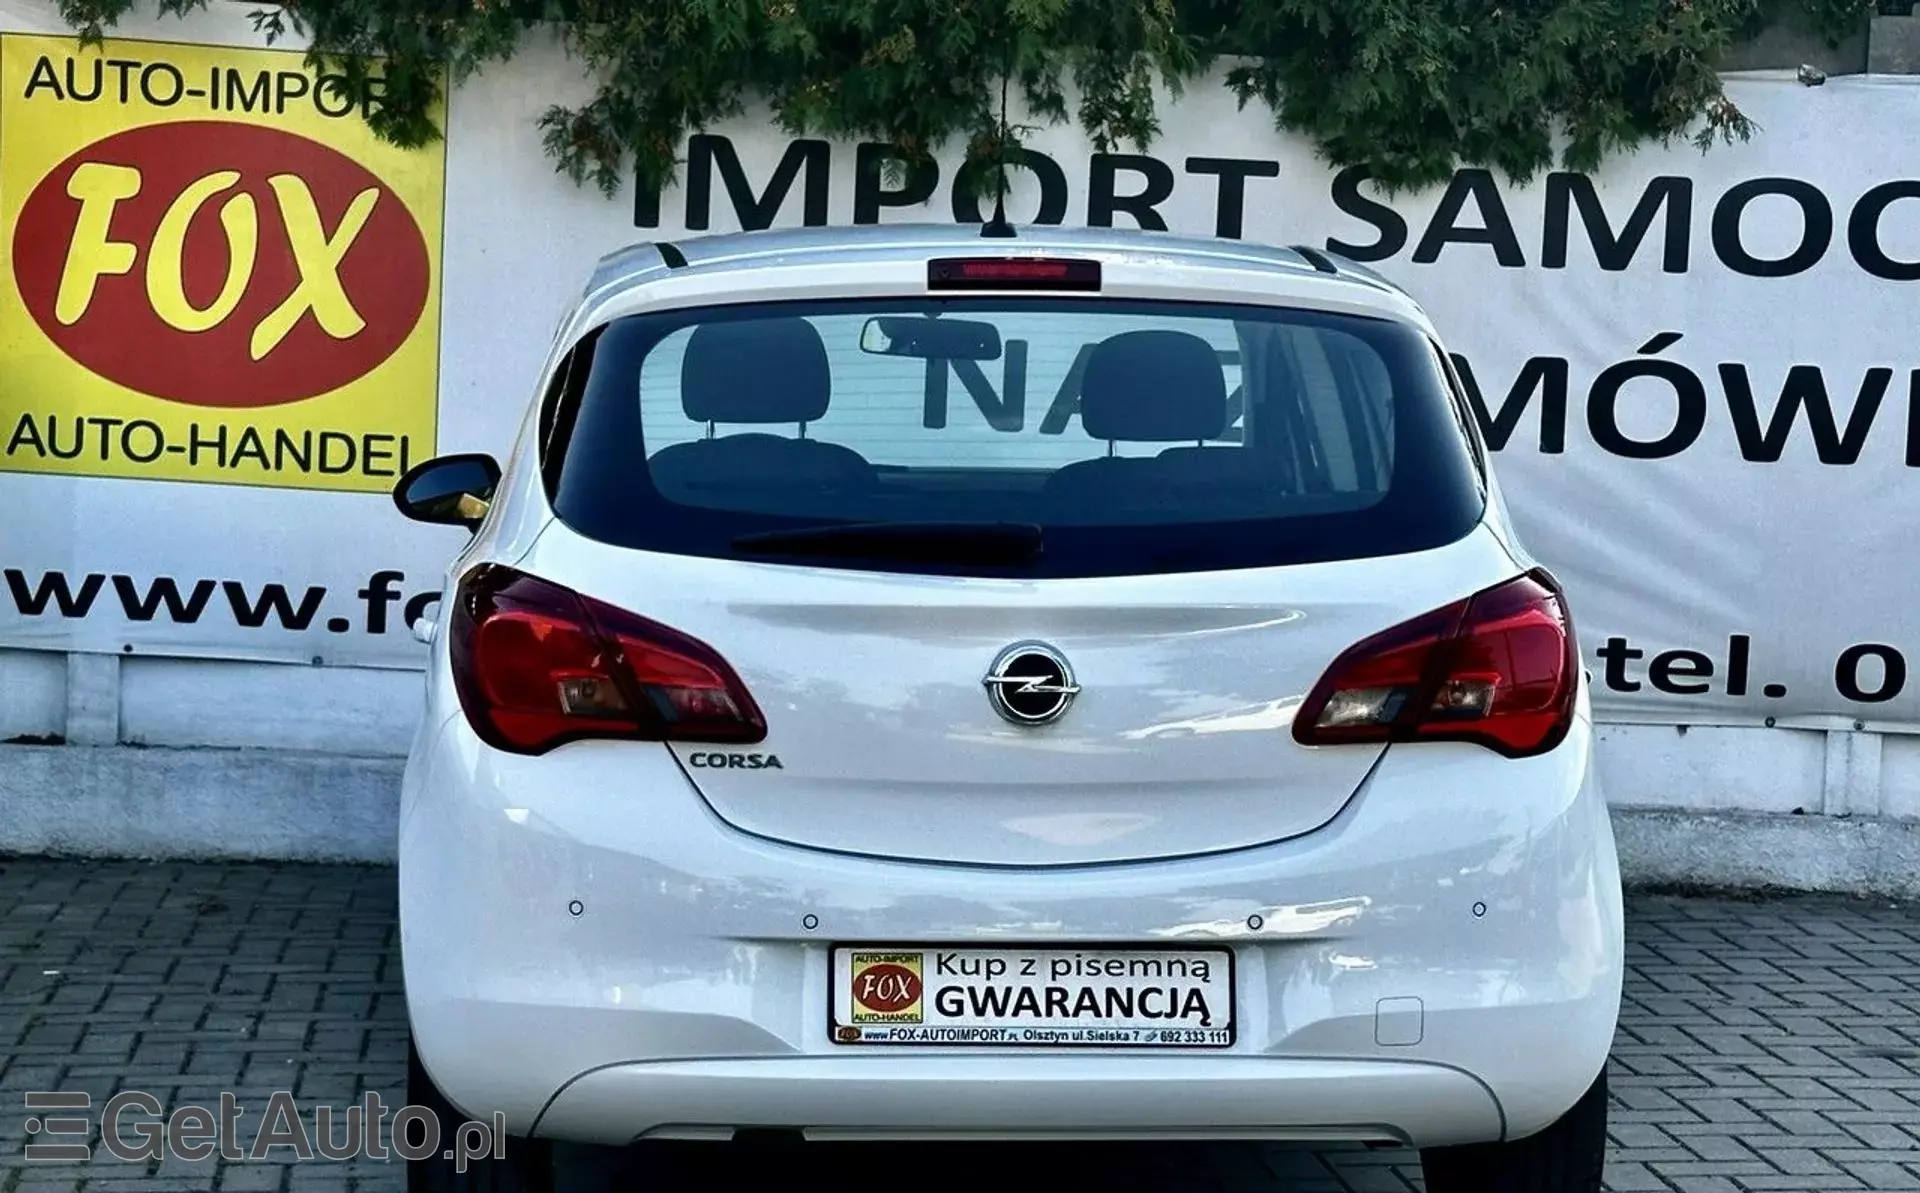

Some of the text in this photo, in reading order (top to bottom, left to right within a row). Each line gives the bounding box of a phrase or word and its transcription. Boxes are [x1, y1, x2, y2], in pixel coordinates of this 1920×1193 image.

[24, 54, 402, 121] AUTO-IMPOR
[55, 162, 380, 362] FOX
[690, 752, 784, 770] CORSA
[936, 953, 1211, 983] Kup z pisemną
[862, 973, 913, 1003] FOX
[935, 985, 1212, 1027] GWARANCJĄ
[1023, 1028, 1069, 1044] Olsztyn
[1132, 1030, 1140, 1042] 7
[1184, 1031, 1206, 1043] 333
[1208, 1031, 1228, 1043] 111
